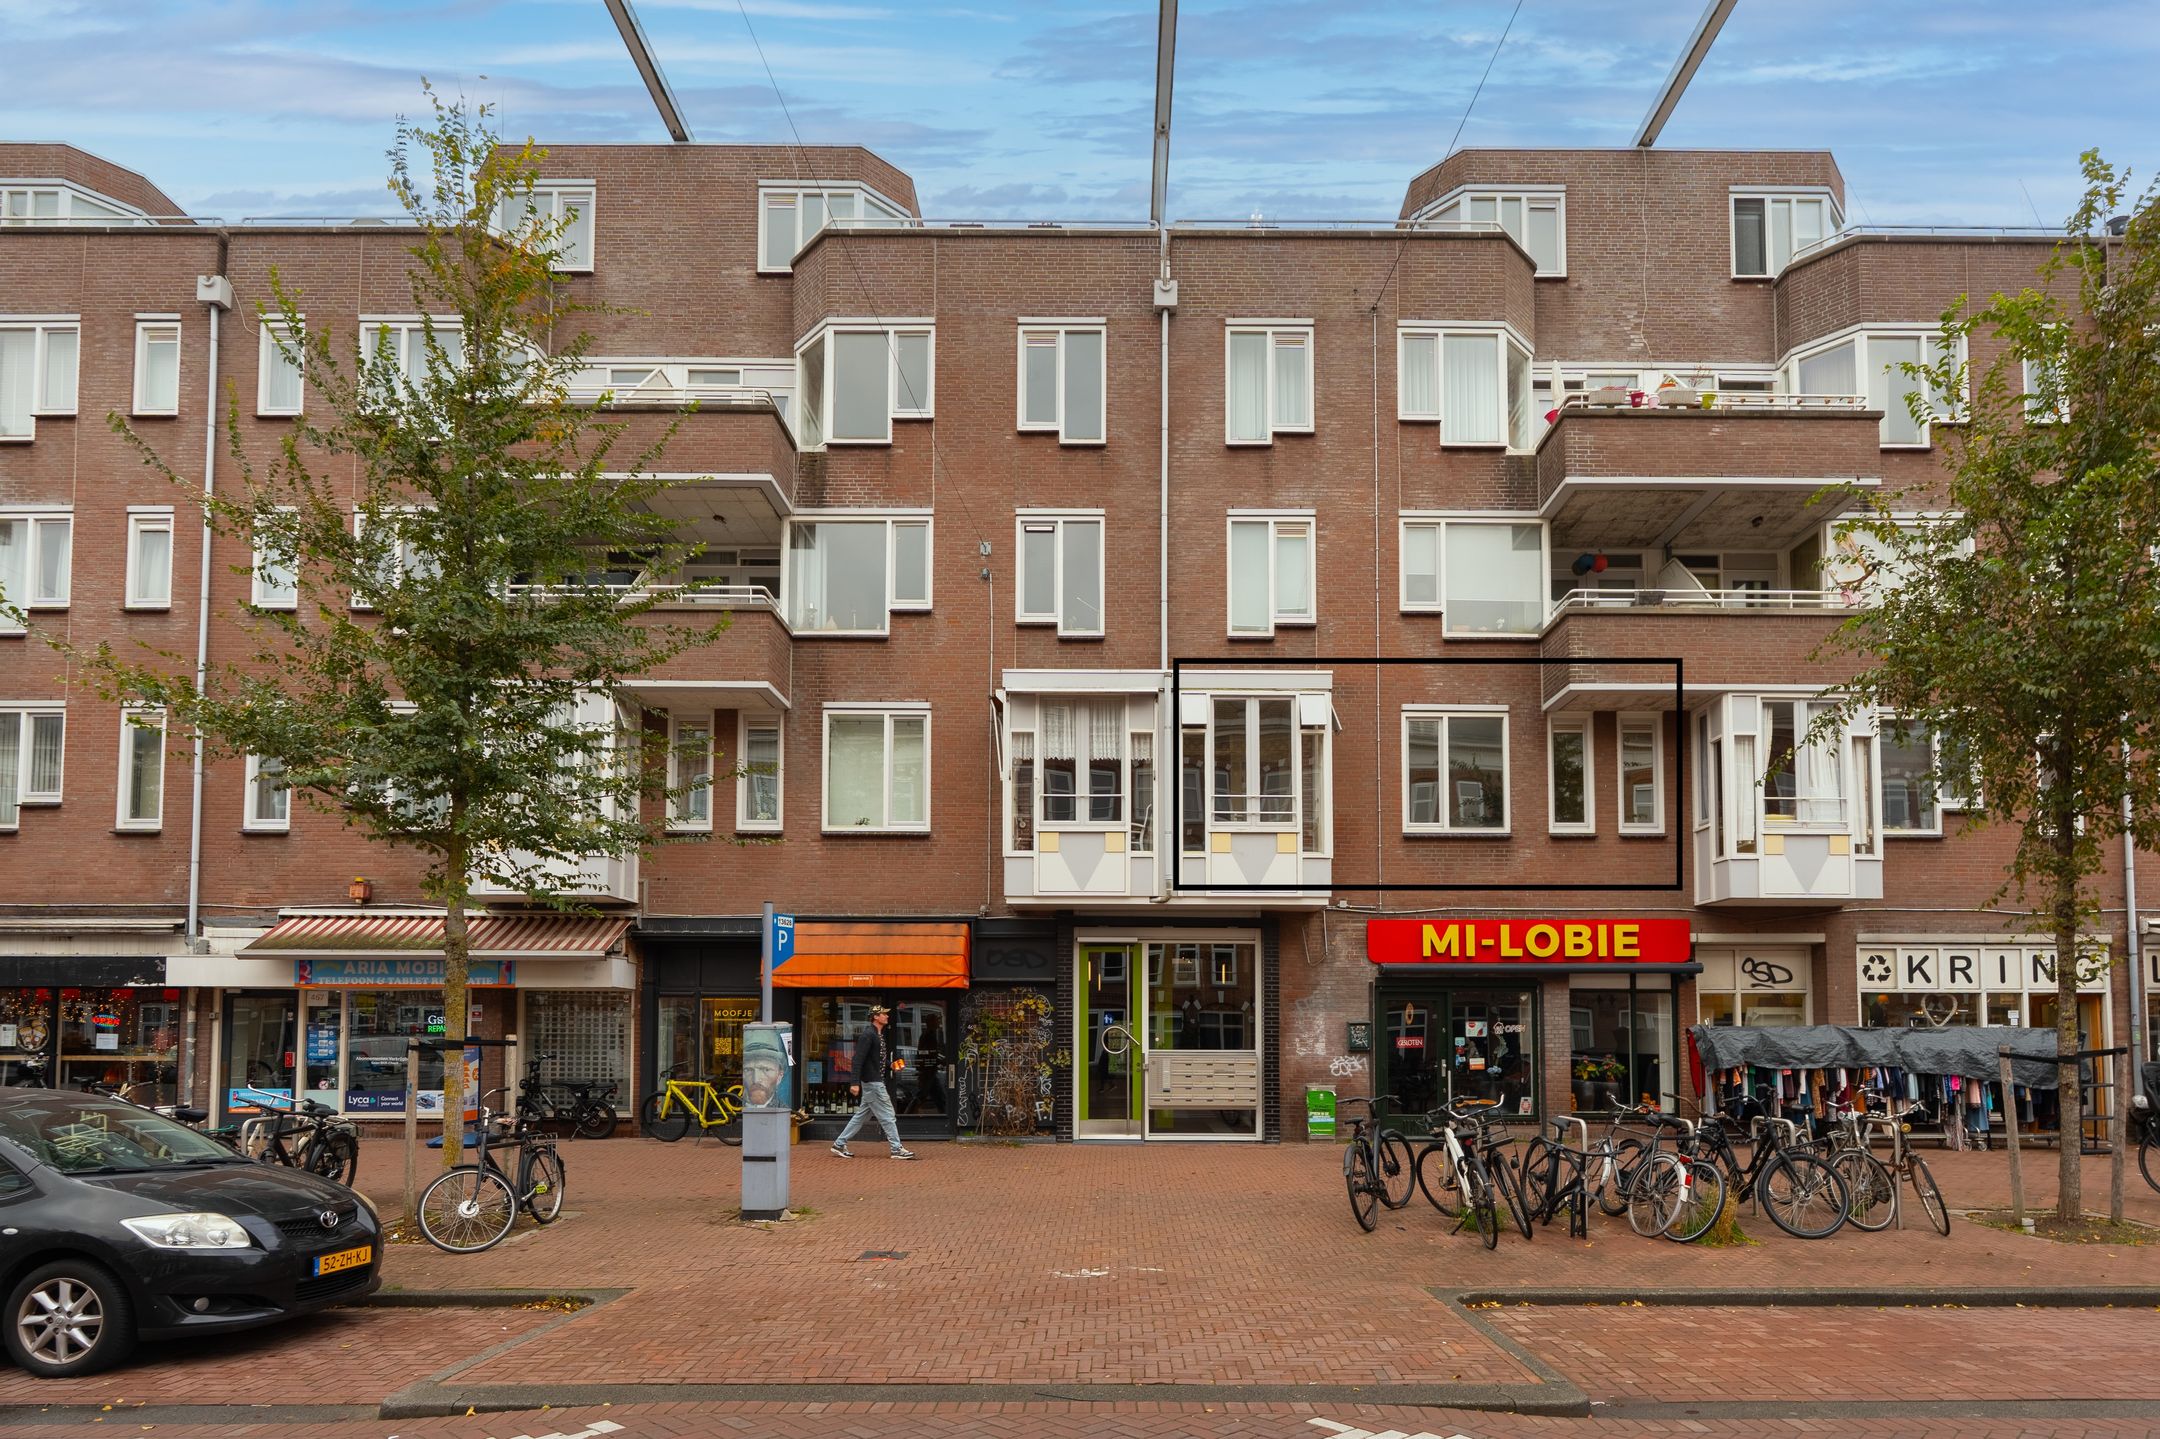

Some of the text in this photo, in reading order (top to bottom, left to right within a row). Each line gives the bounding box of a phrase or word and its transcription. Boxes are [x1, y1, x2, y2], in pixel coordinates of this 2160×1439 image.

[779, 930, 788, 951] P
[1422, 924, 1640, 957] MI-LOBIE
[344, 961, 444, 975] ARIA MOBI
[318, 976, 374, 985] TELEFOON
[388, 976, 429, 985] TABLET
[348, 1096, 370, 1105] Lyca
[323, 1248, 368, 1271] 52-ZH-KJ
